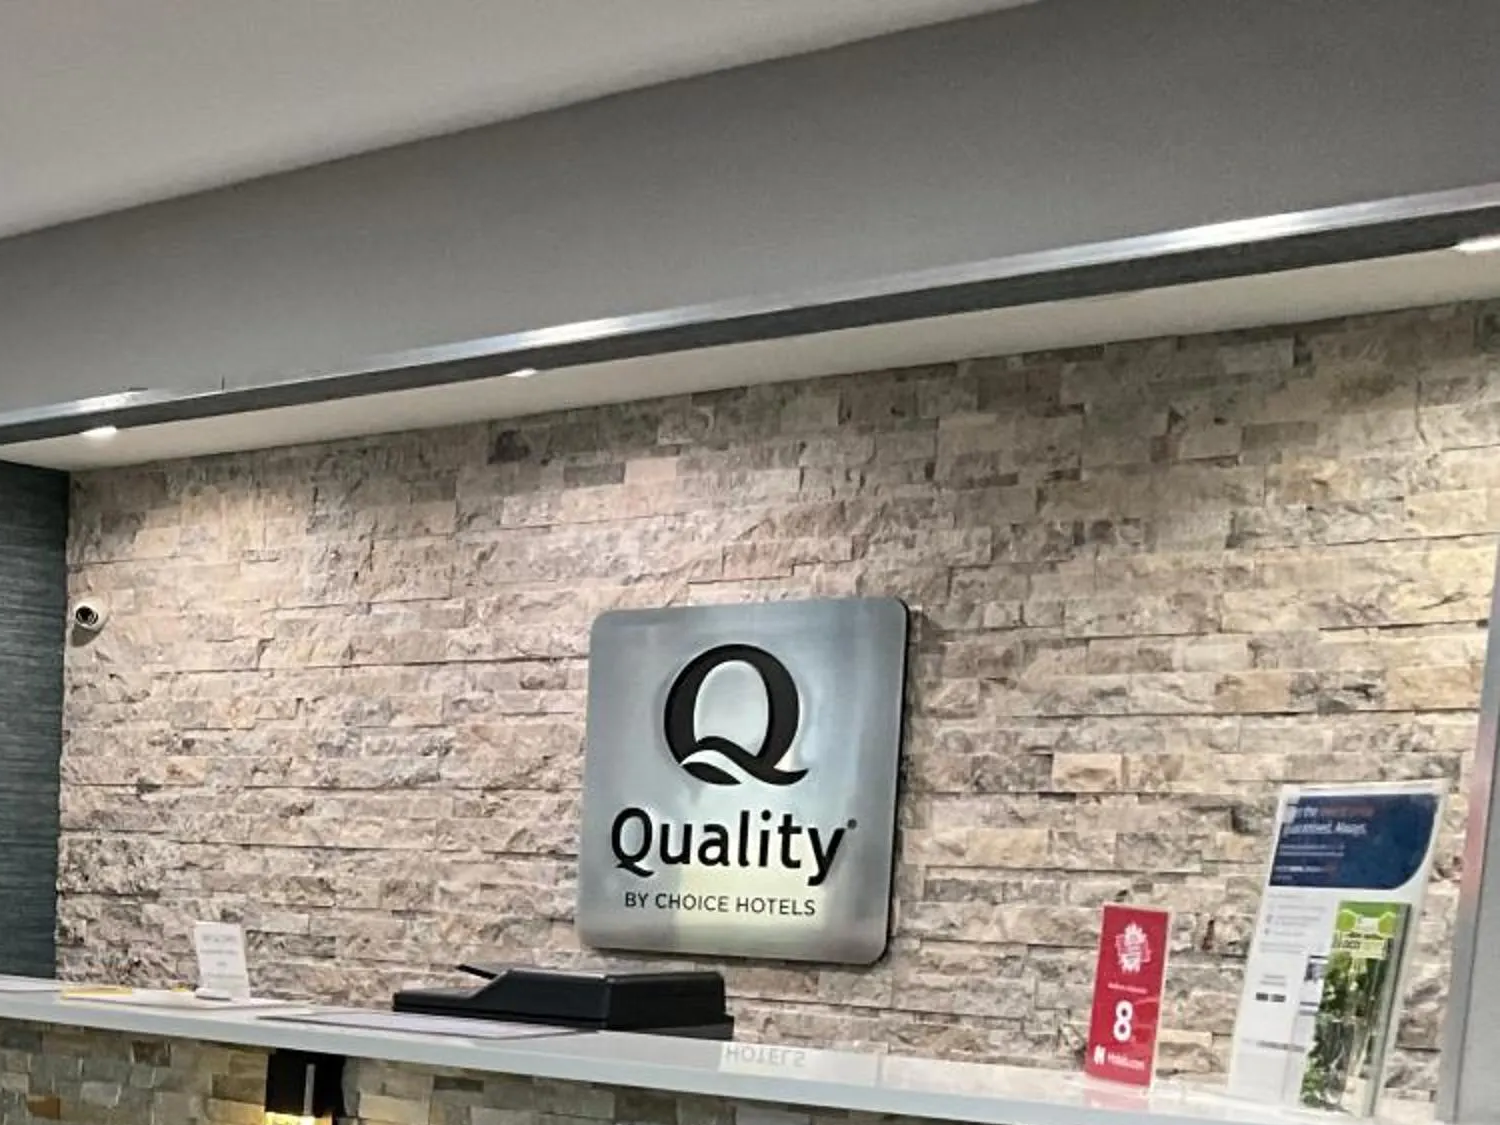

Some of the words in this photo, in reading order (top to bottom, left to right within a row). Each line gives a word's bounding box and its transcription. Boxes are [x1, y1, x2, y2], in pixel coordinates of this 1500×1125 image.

[664, 643, 809, 786] Q
[610, 806, 846, 886] Quality
[624, 891, 649, 908] BY
[654, 893, 729, 912] CHOICE
[735, 896, 816, 916] HOTELS
[1113, 1000, 1133, 1042] 8
